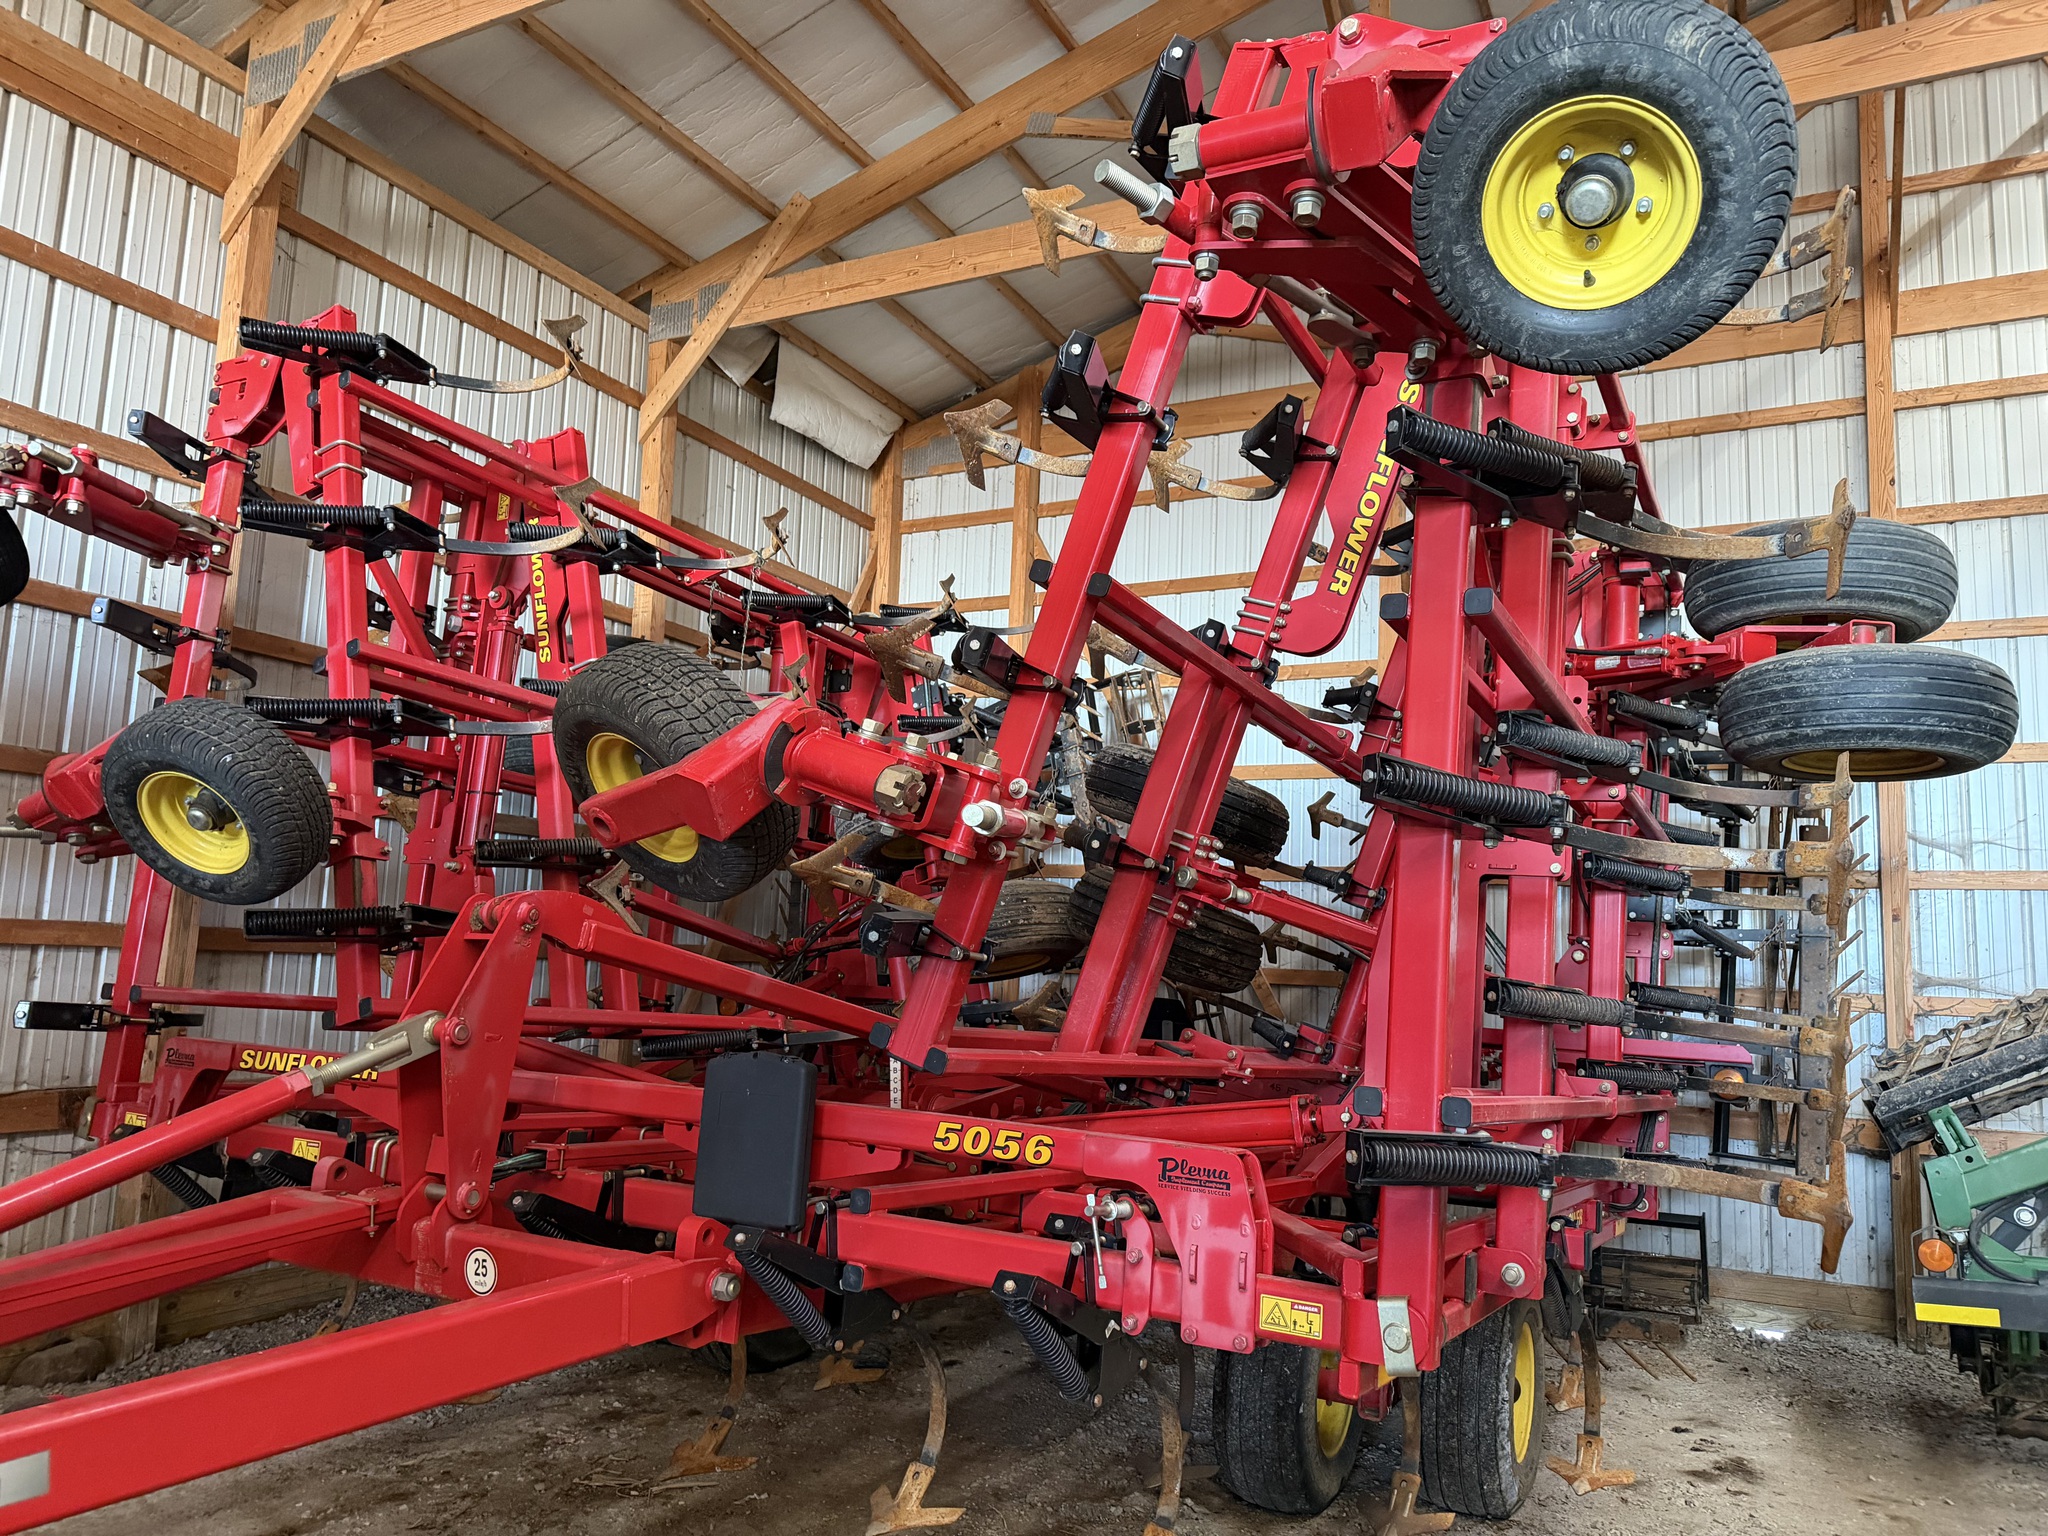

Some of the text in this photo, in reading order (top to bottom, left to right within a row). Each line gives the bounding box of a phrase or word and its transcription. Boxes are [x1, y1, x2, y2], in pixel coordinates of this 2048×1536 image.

[1328, 379, 1421, 597] SFLOWER
[932, 1121, 1055, 1167] 5056
[1158, 1157, 1231, 1181] Plevna
[1157, 1183, 1180, 1191] SERVICE
[1207, 1189, 1232, 1197] SUCCESS
[474, 1257, 488, 1278] 25
